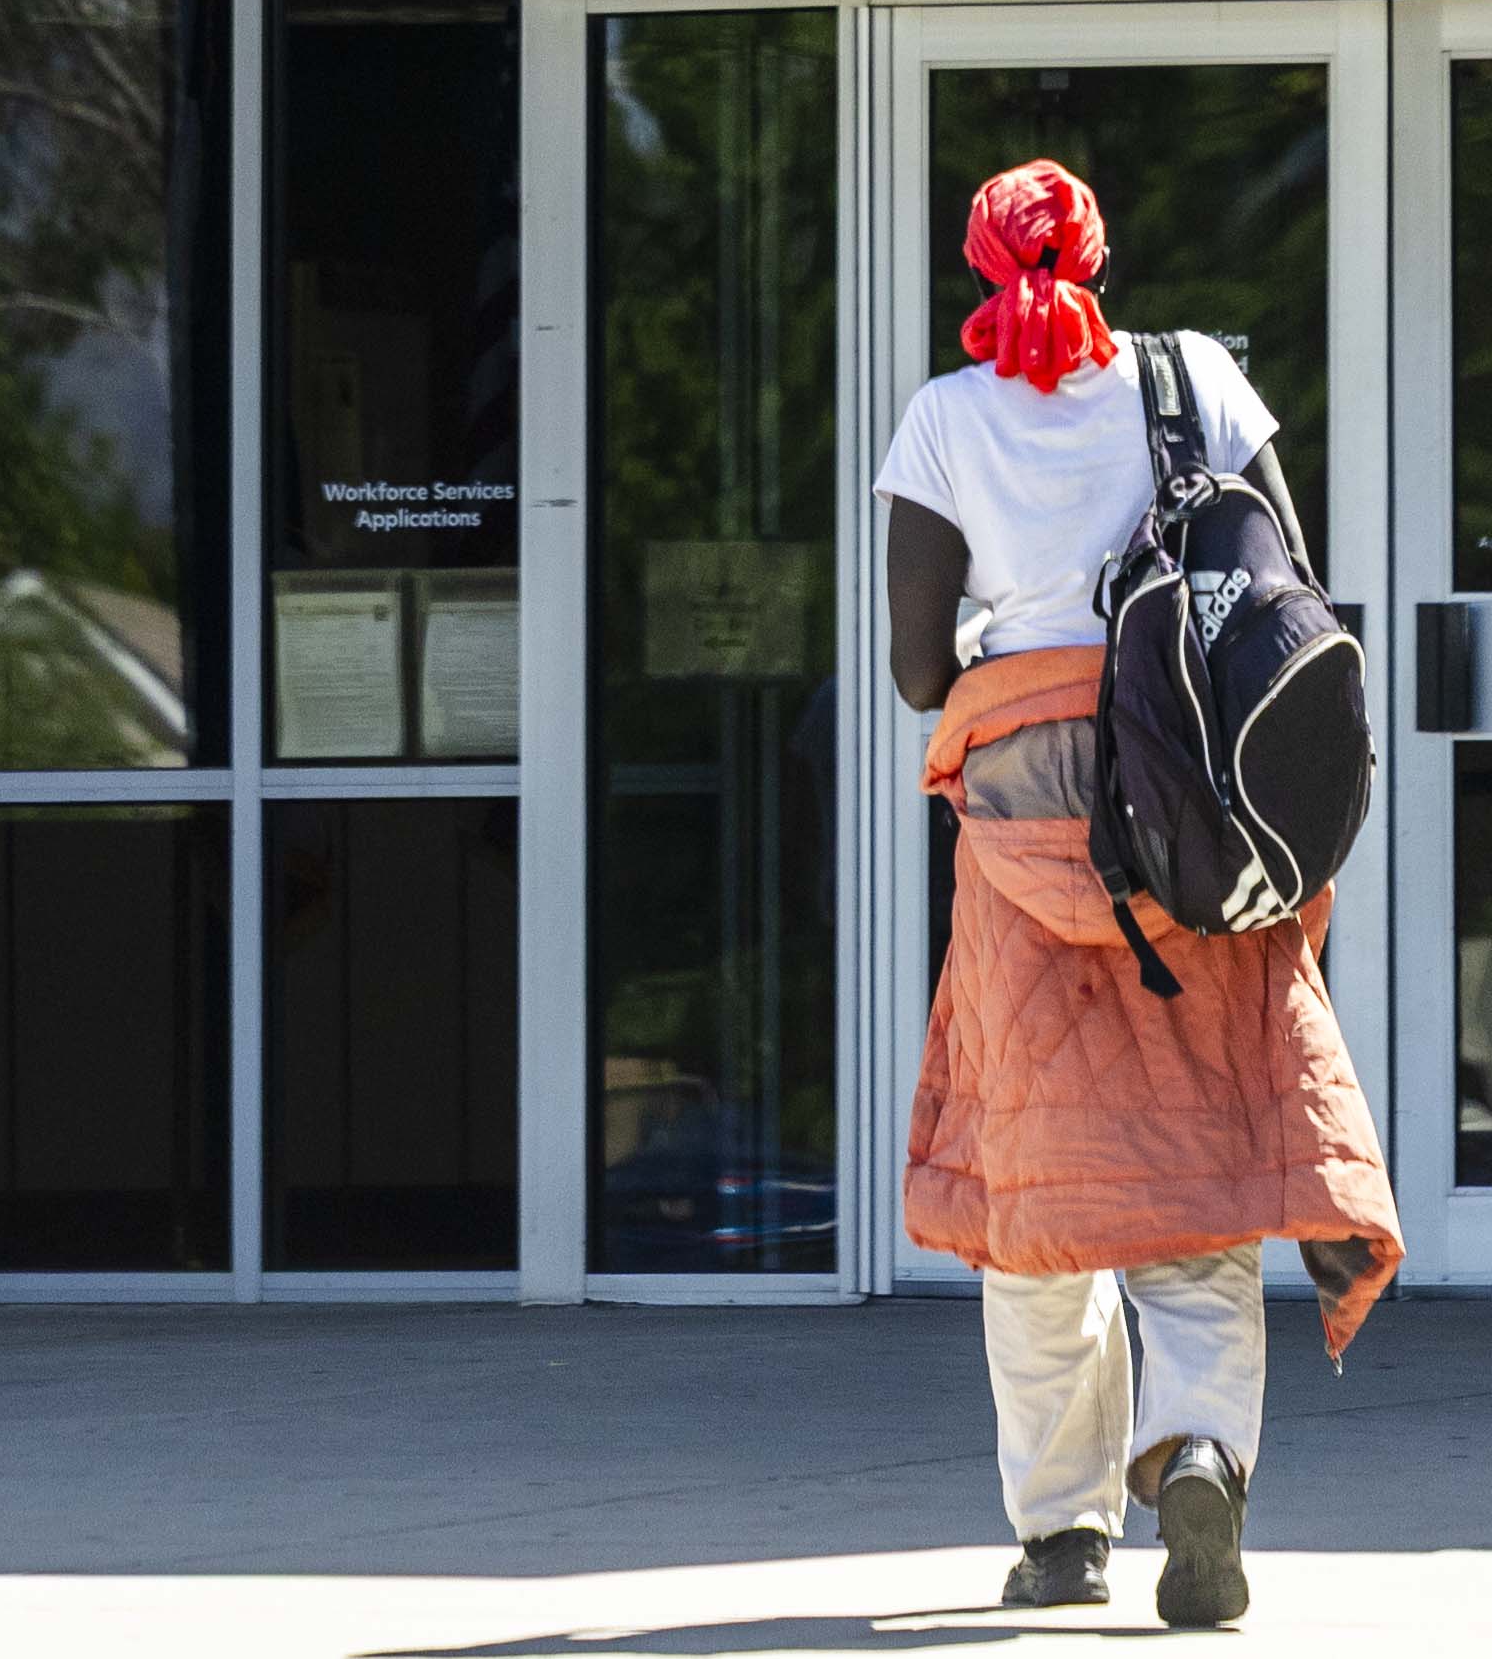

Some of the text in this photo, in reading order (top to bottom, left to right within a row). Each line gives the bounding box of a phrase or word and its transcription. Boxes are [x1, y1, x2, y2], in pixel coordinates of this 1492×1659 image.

[322, 481, 515, 502] Workforce Services
[356, 508, 482, 531] Applications
[1202, 568, 1251, 656] didas
